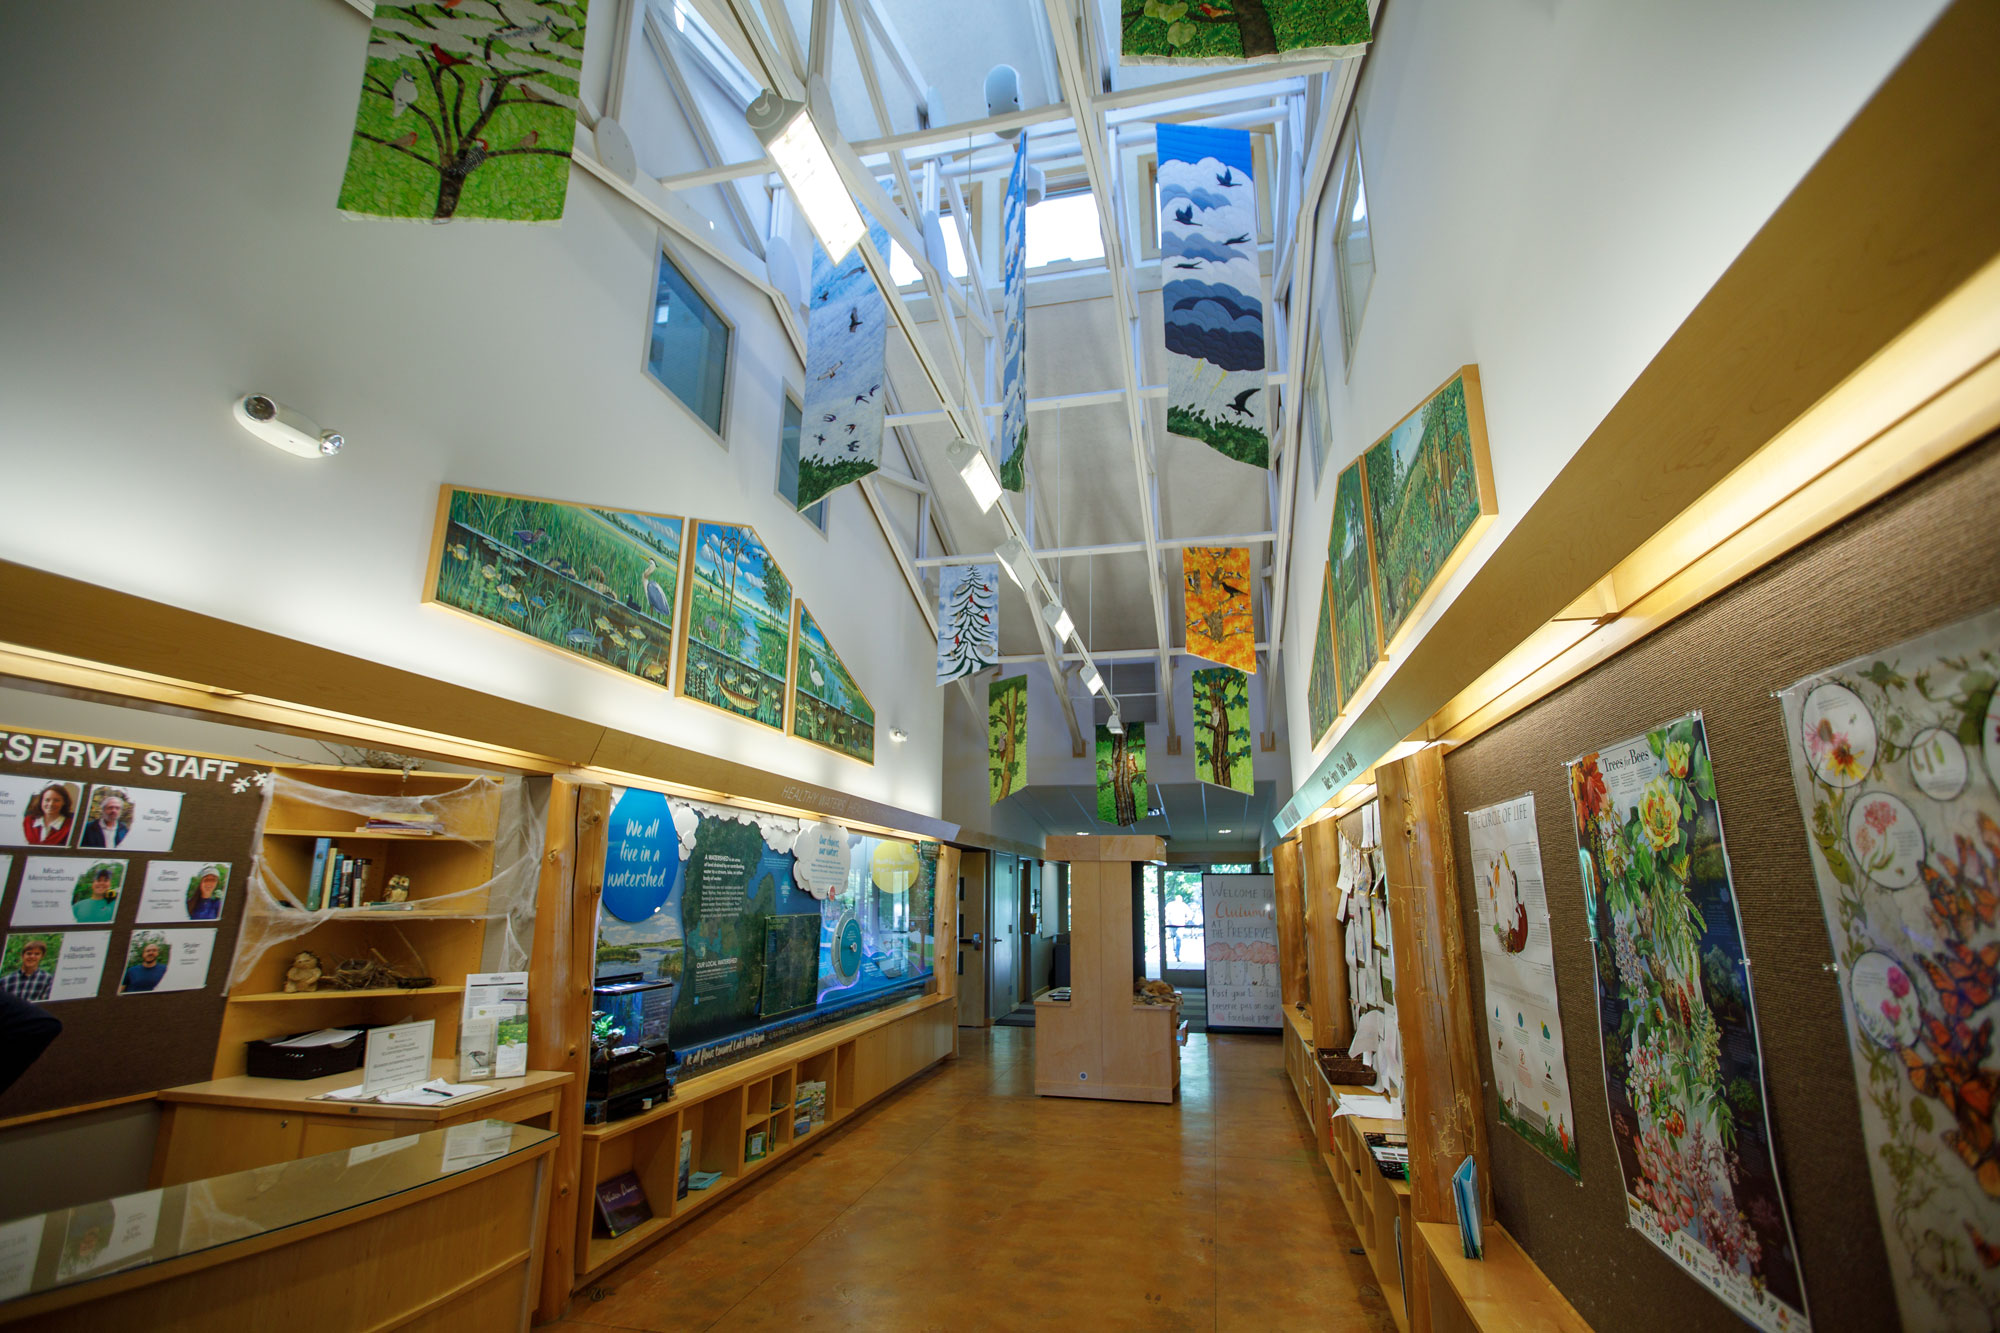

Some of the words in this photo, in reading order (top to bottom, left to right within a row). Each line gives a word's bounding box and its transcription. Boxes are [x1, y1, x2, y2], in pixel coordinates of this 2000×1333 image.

[142, 752, 239, 782] STAFF
[1602, 758, 1624, 772] Trees
[1629, 749, 1650, 764] Bees
[782, 785, 818, 806] HEALTHY
[818, 794, 846, 812] WATERS
[1471, 816, 1480, 830] THE
[1481, 810, 1501, 828] CIRCLE
[1502, 807, 1511, 823] OF
[1514, 804, 1527, 820] LIFE
[626, 819, 642, 838] We
[645, 818, 660, 838] all
[620, 840, 638, 862] live
[641, 845, 650, 862] in
[653, 849, 660, 862] a
[607, 866, 666, 887] watershed
[1211, 881, 1258, 898] WELCOME
[1263, 888, 1273, 898] TO
[1216, 901, 1273, 920] Autumn
[1212, 920, 1221, 928] AT
[1212, 928, 1225, 938] THE
[1227, 920, 1271, 938] PRESERVE
[1212, 988, 1228, 998] Post
